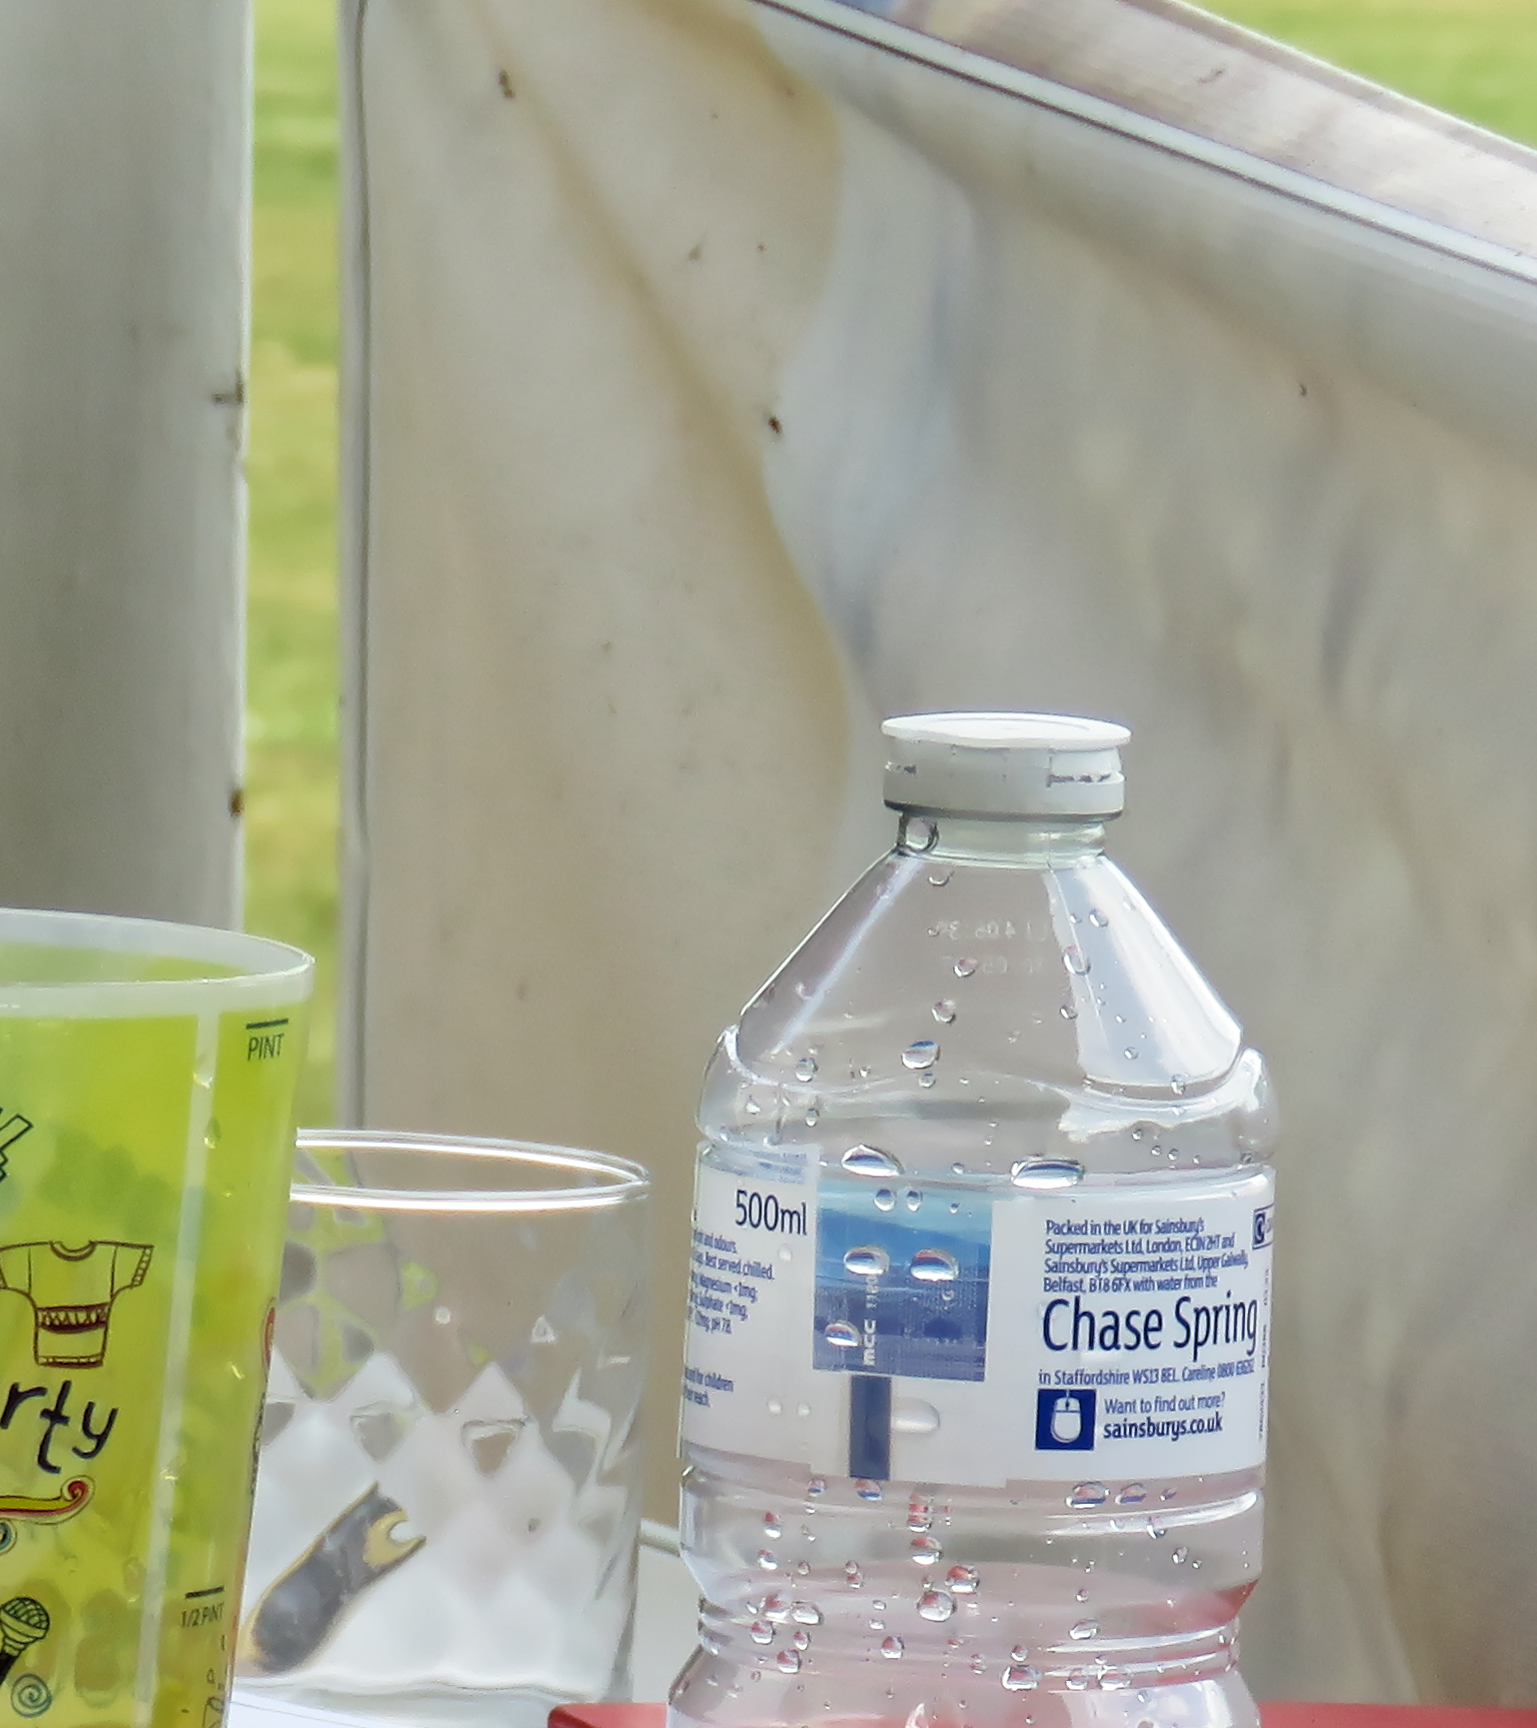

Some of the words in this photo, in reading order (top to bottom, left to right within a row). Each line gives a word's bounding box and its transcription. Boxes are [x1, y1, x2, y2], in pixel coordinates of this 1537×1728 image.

[247, 1031, 285, 1061] PINT
[735, 1188, 808, 1236] 500ml
[1045, 1218, 1088, 1236] Packed
[1090, 1219, 1102, 1235] in
[1103, 1219, 1122, 1236] the
[1123, 1220, 1138, 1235] UK
[1139, 1217, 1153, 1235] for
[1155, 1216, 1205, 1238] Sainsbury's
[1045, 1239, 1123, 1259] Supermarkets
[1222, 1232, 1235, 1249] and
[1044, 1257, 1109, 1279] Sainsbury's
[1110, 1256, 1178, 1279] Supermarkets
[1088, 1276, 1111, 1292] BT8
[1112, 1276, 1132, 1292] 6FX
[1133, 1275, 1155, 1292] with
[1155, 1274, 1184, 1291] water
[1184, 1273, 1204, 1290] from
[1204, 1273, 1219, 1288] the
[1043, 1295, 1163, 1352] Chase
[1173, 1288, 1259, 1363] Spring
[1038, 1368, 1051, 1386] in
[1054, 1366, 1131, 1386] Staffordshire
[1132, 1367, 1160, 1385] WS13
[1182, 1364, 1216, 1383] Careline
[1103, 1397, 1138, 1414] Want
[1139, 1396, 1152, 1413] to
[1153, 1395, 1178, 1413] find
[1178, 1394, 1196, 1412] out
[1196, 1390, 1226, 1410] more?
[1103, 1410, 1224, 1442] sainsburys.co.uk
